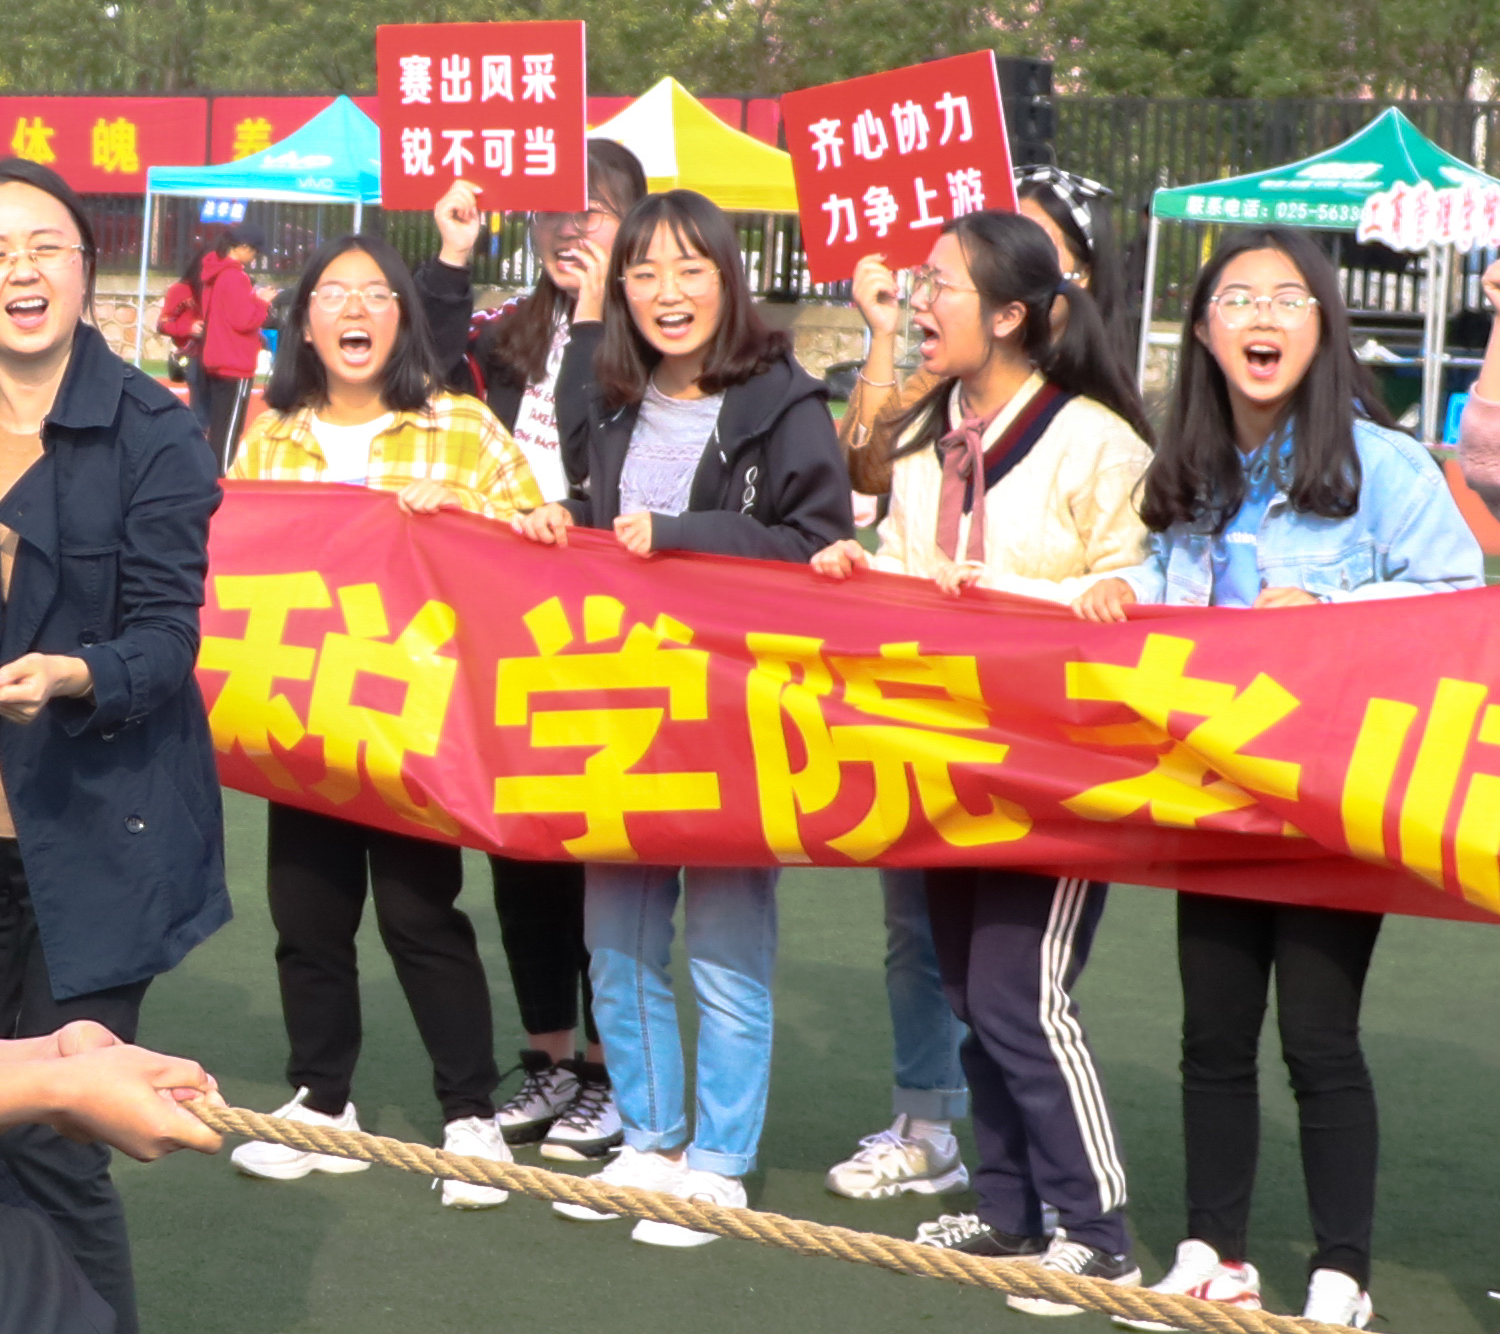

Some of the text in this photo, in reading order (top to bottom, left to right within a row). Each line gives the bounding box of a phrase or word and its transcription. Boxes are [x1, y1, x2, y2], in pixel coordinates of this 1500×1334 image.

[400, 53, 556, 104] 赛出风采
[402, 126, 557, 177] 锐不可当
[807, 91, 974, 171] 齐心协力
[821, 167, 986, 246] 力争上游
